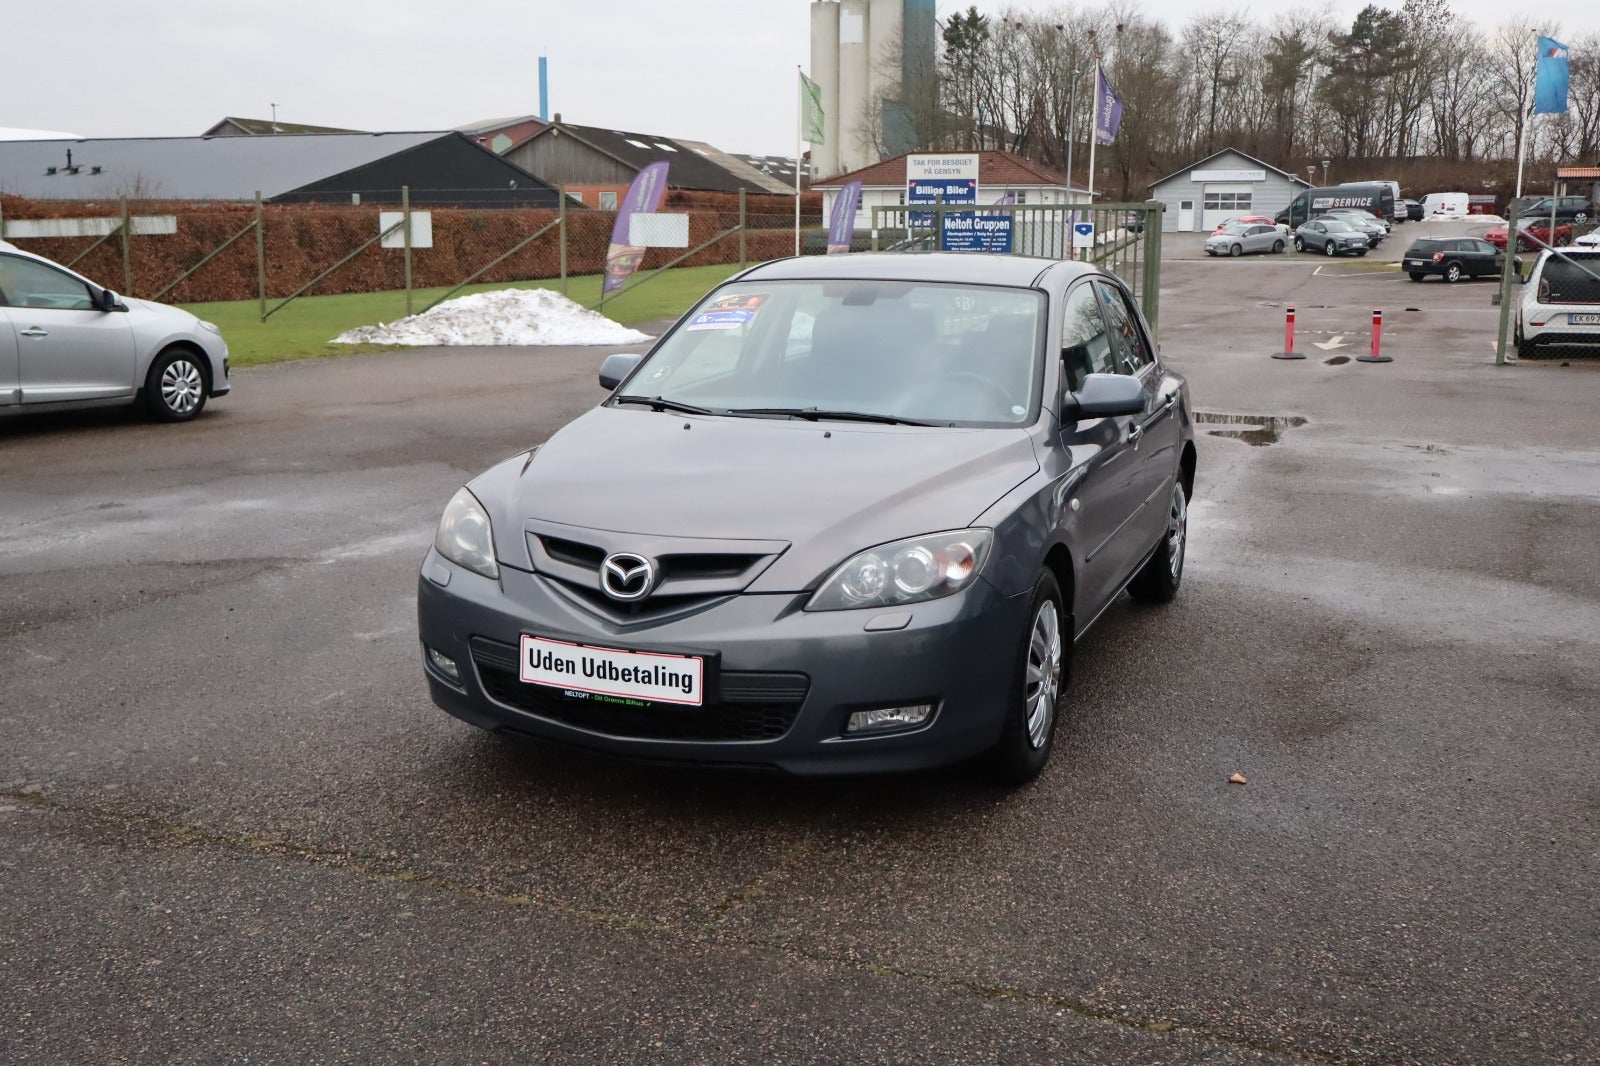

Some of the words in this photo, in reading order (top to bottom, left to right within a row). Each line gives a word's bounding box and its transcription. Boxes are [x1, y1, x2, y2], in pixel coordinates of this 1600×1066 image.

[923, 167, 933, 175] PÅ
[915, 185, 944, 196] Billige
[946, 185, 969, 195] Biler
[1333, 197, 1373, 208] SERVICE
[944, 217, 973, 230] Neltoft
[974, 217, 1010, 231] Gruppen
[529, 647, 576, 675] Uden
[582, 656, 693, 694] Udbetaling
[564, 690, 590, 699] NELTOFT
